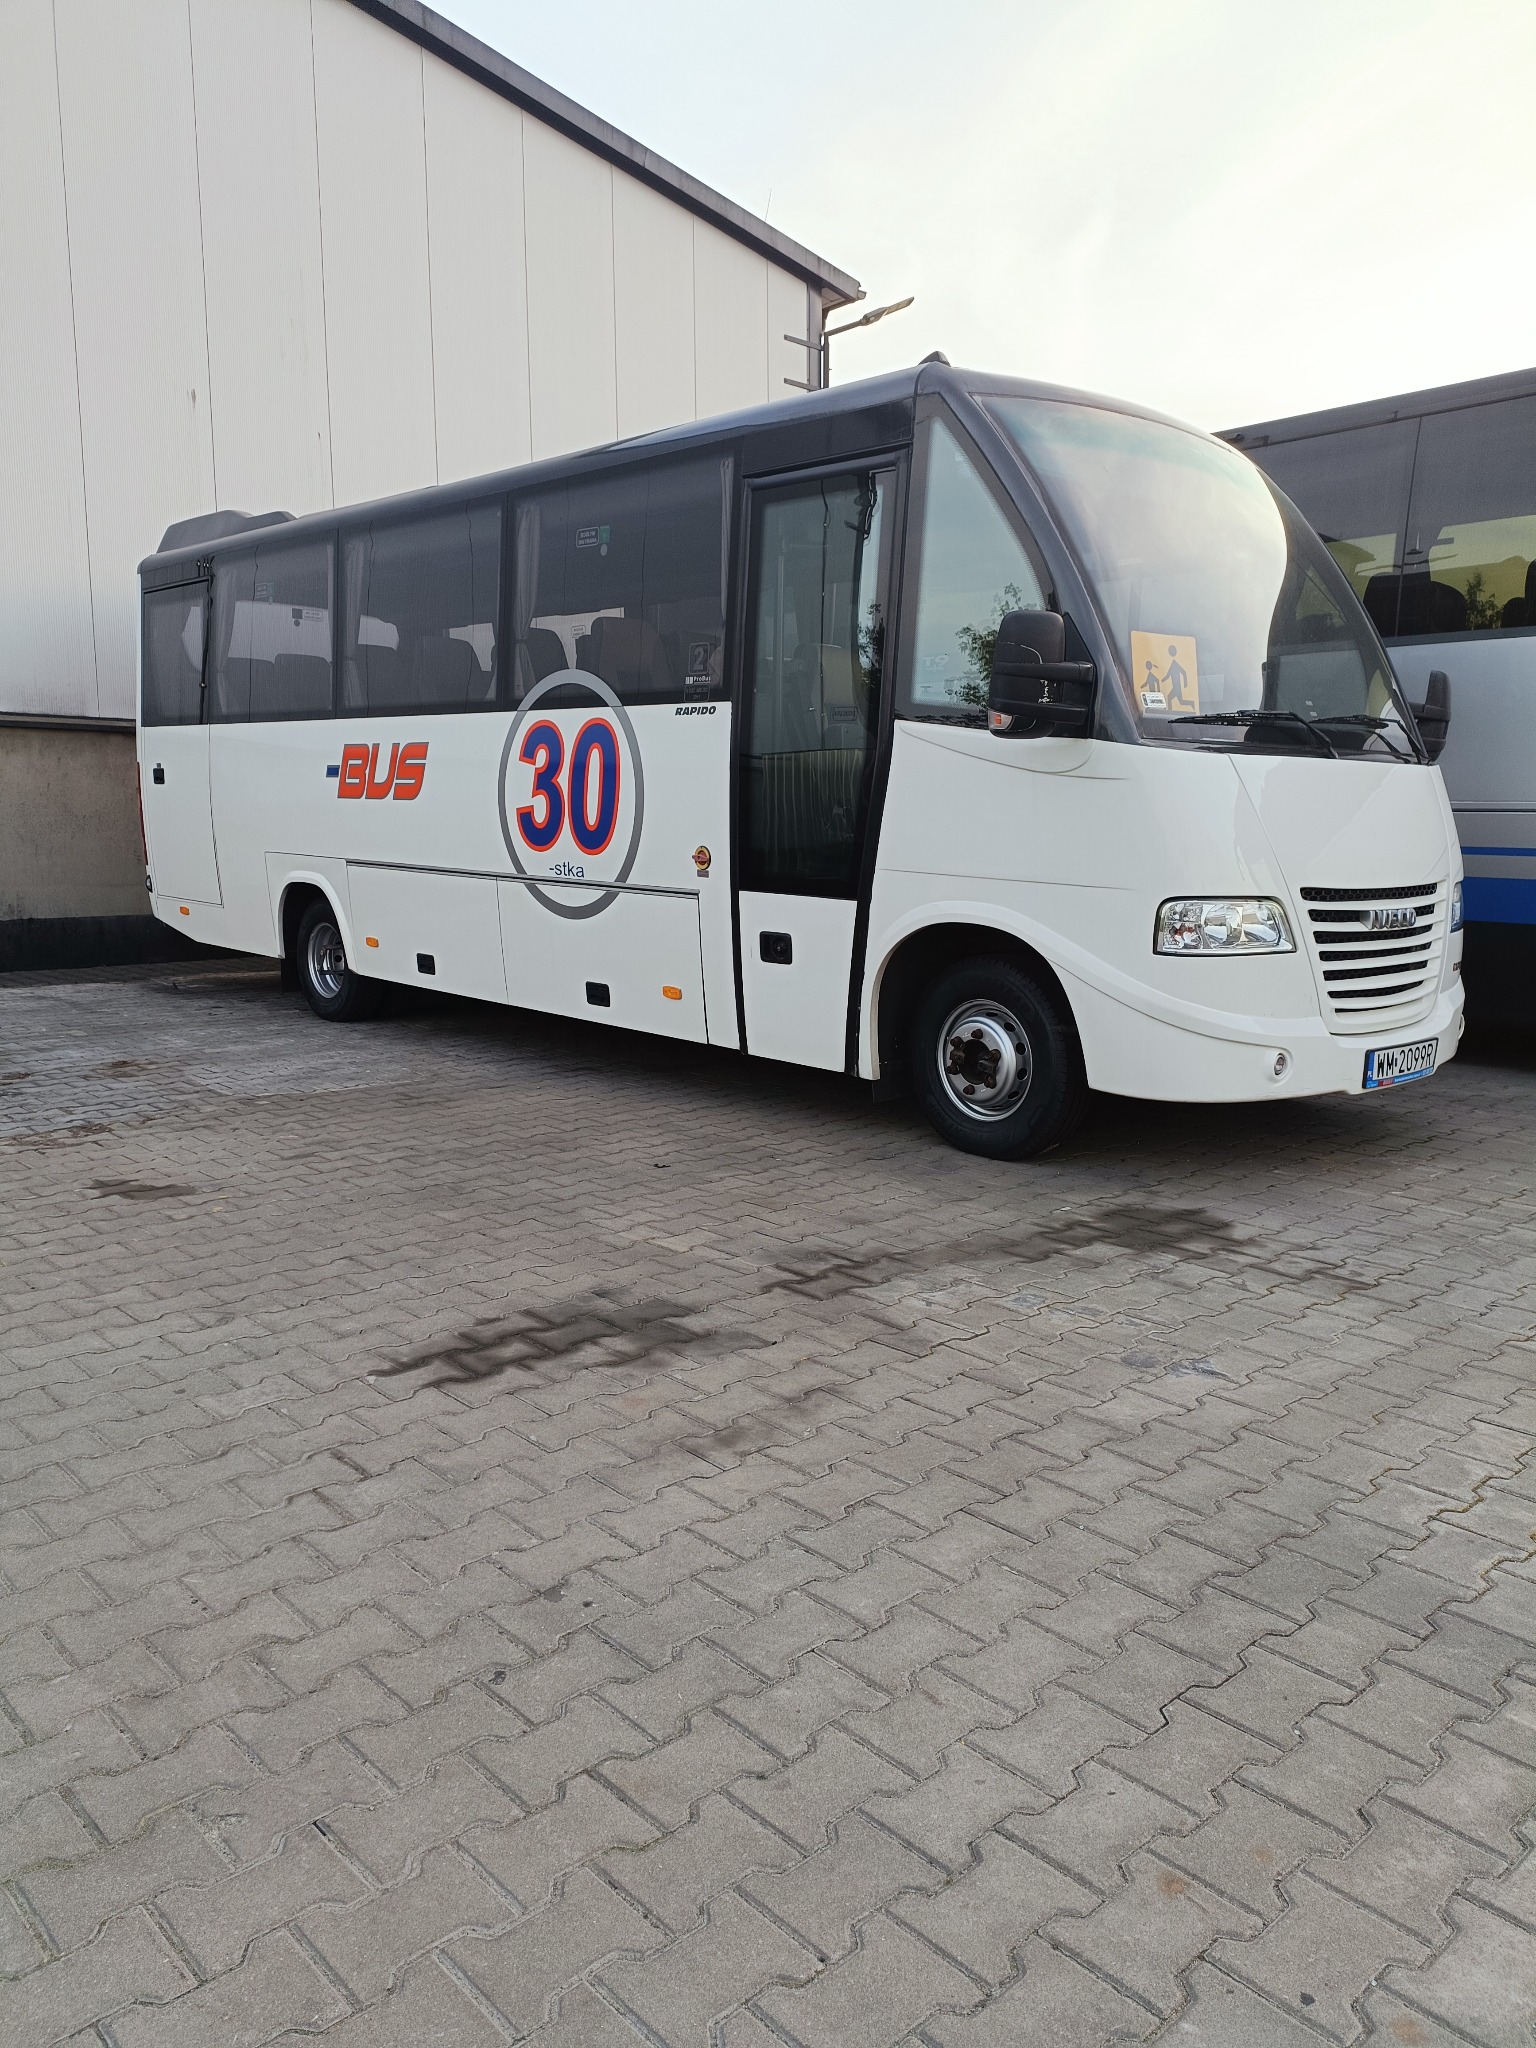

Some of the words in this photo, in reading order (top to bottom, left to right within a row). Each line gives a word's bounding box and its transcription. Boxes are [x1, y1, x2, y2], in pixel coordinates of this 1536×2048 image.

[674, 705, 717, 716] RAPIDO
[516, 717, 621, 856] 30
[549, 862, 585, 878] -stka
[1367, 907, 1416, 930] IVECO
